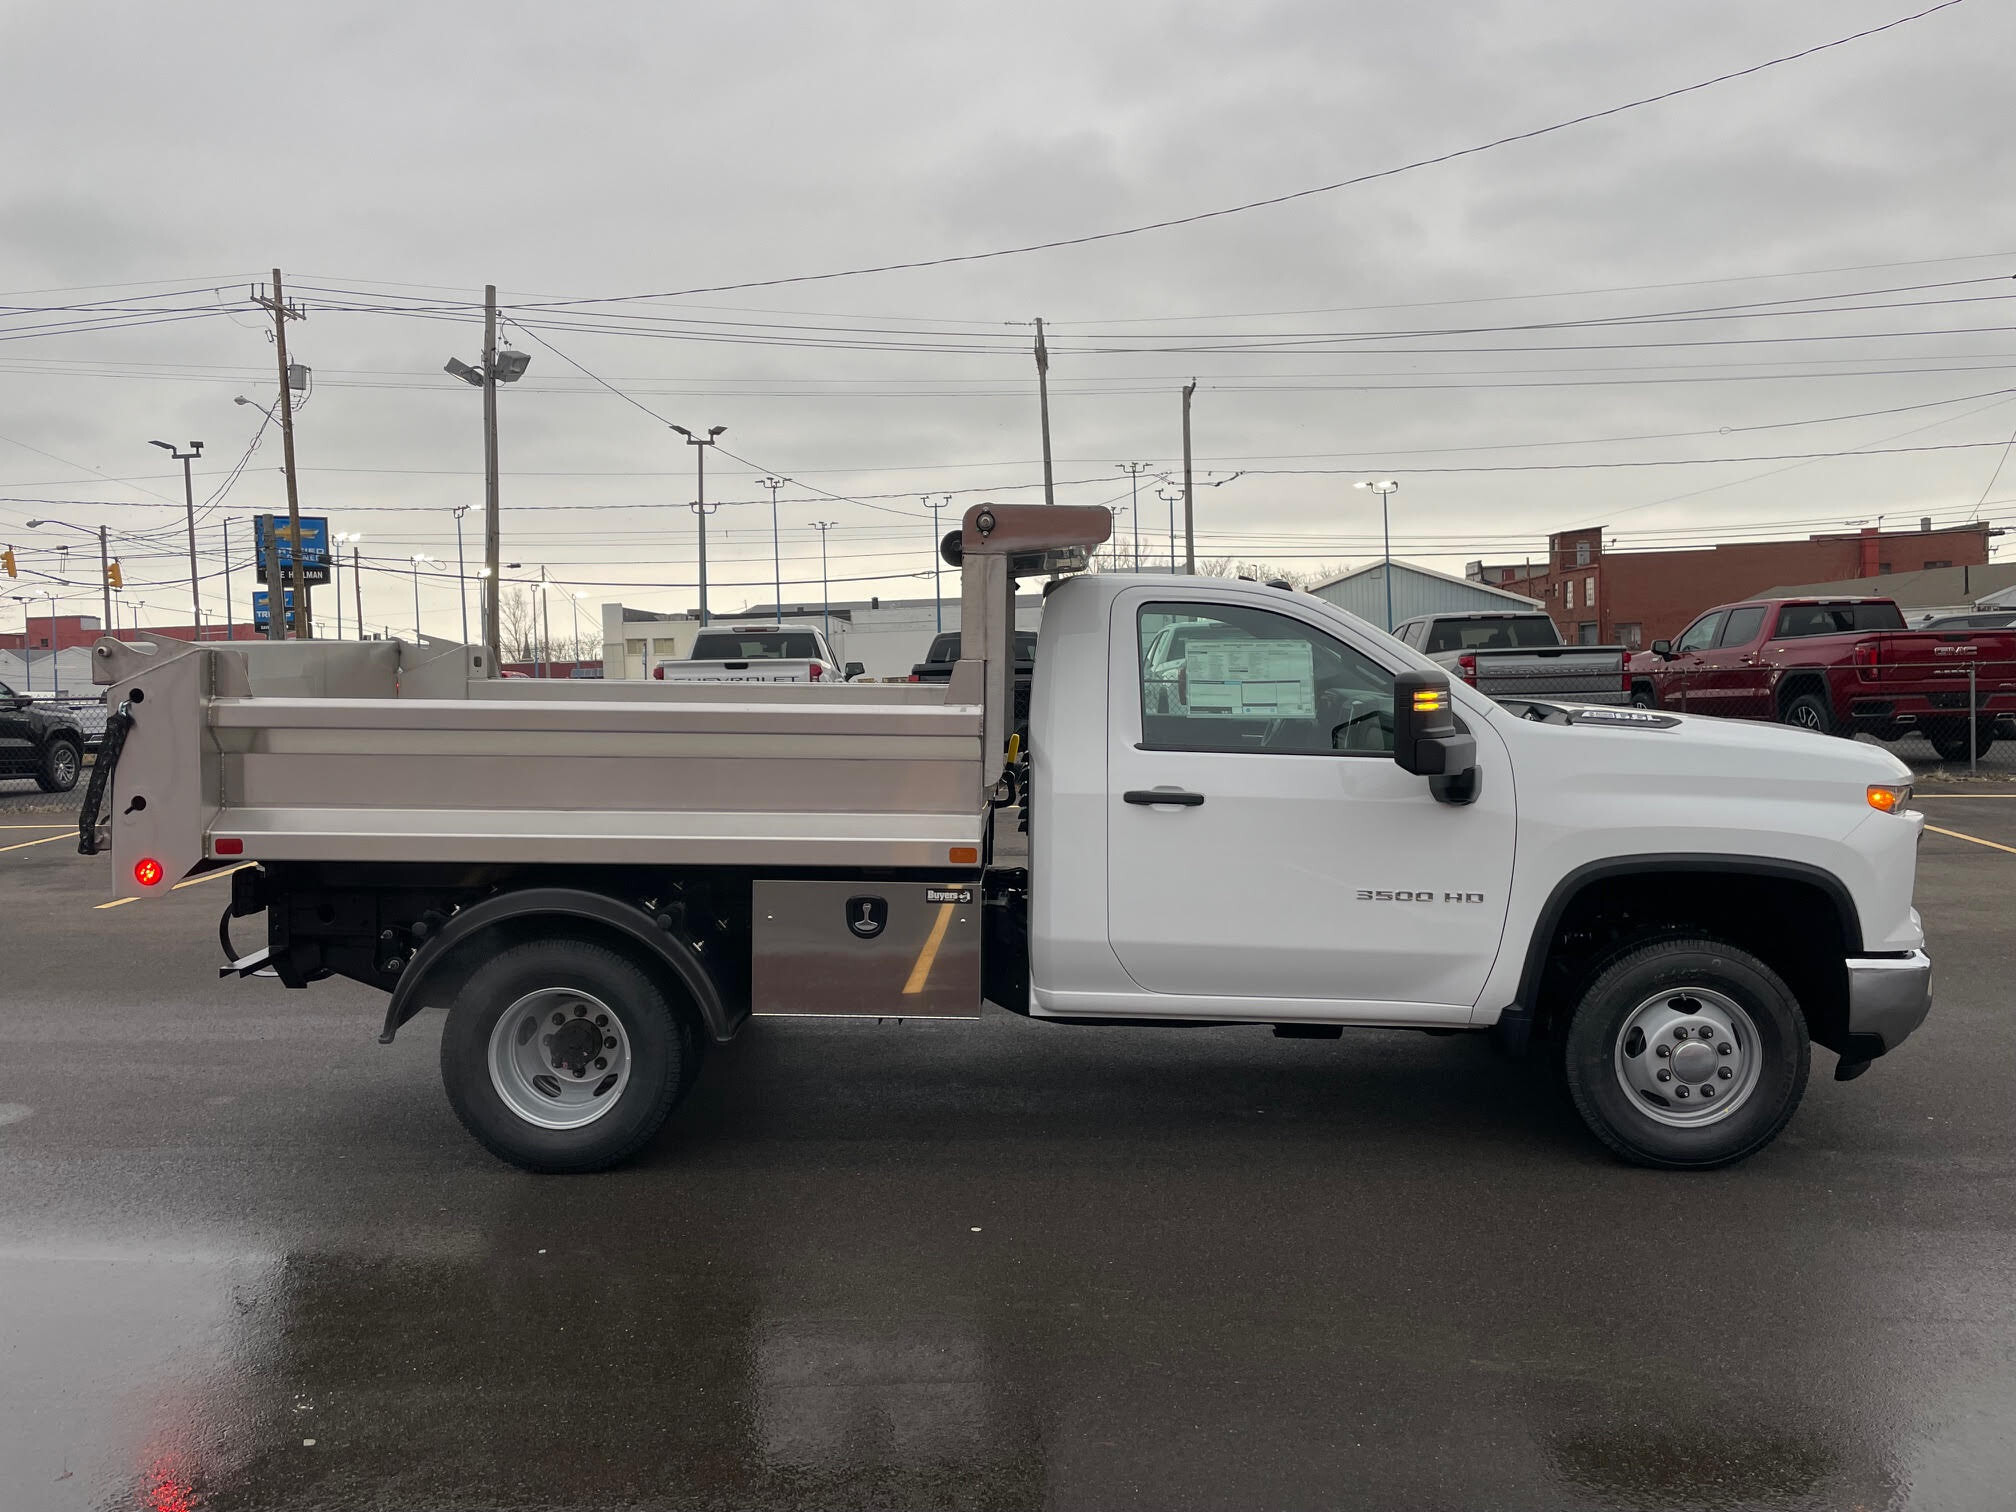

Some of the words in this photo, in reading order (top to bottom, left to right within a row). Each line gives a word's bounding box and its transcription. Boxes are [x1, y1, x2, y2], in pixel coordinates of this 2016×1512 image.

[288, 570, 323, 579] HLMAN
[1934, 646, 1978, 656] GMC
[927, 889, 958, 900] Buyers
[1356, 890, 1434, 903] 3500
[1444, 892, 1484, 904] HD
